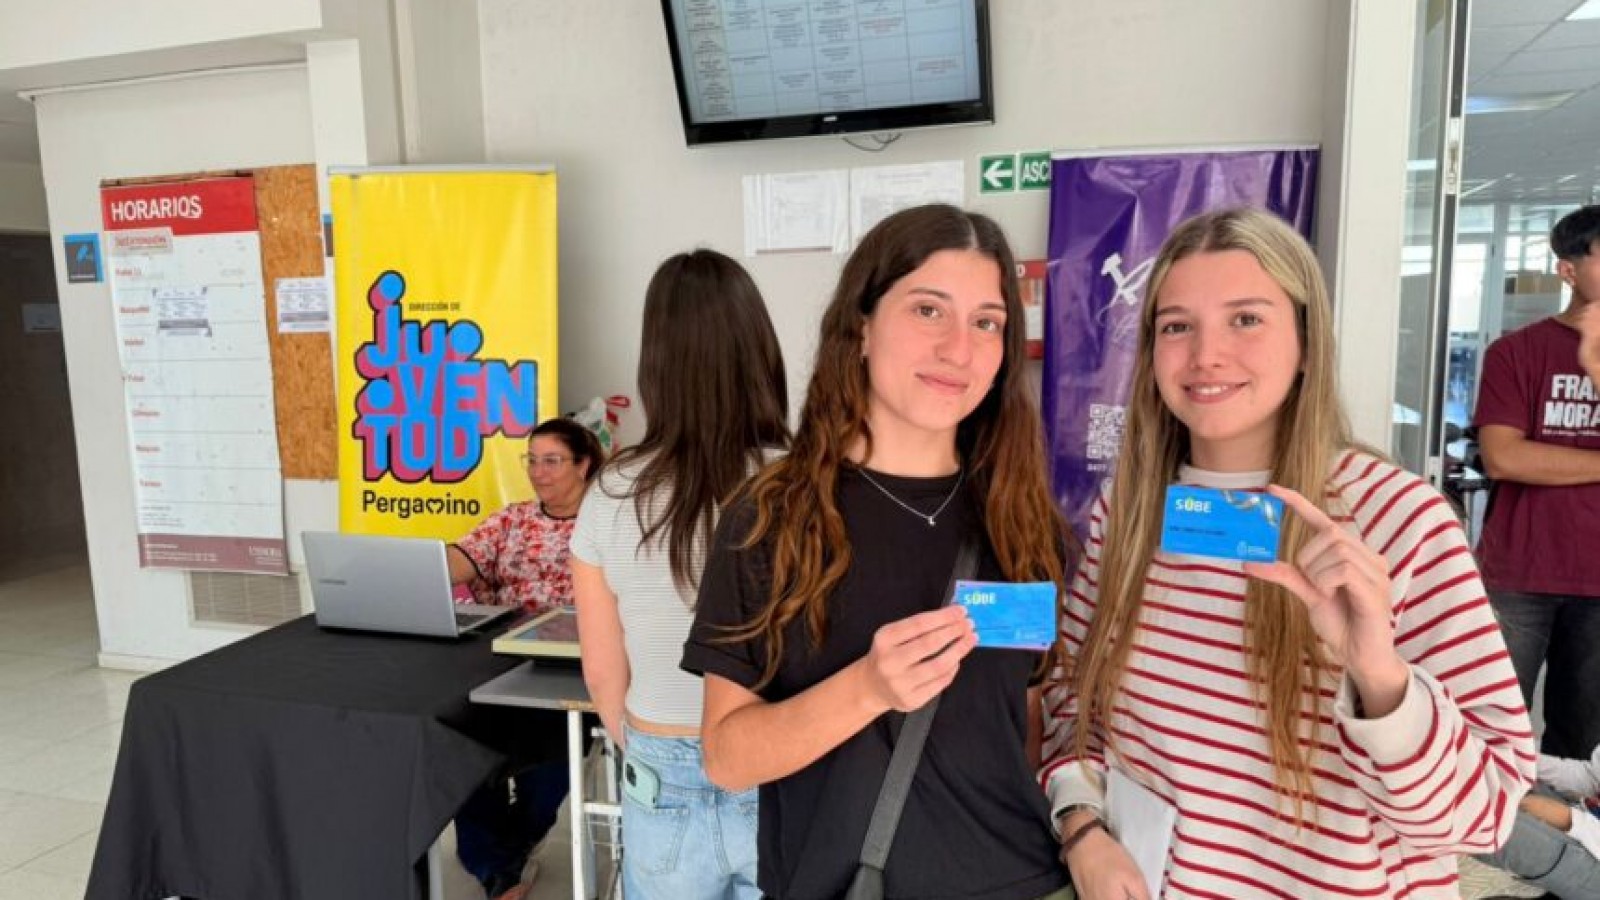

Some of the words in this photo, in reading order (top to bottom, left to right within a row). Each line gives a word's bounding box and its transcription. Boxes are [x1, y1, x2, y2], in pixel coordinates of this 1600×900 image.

[111, 194, 204, 223] HORARIOS
[450, 302, 461, 312] DE
[1551, 374, 1598, 402] FRA
[362, 490, 481, 518] Pergamino
